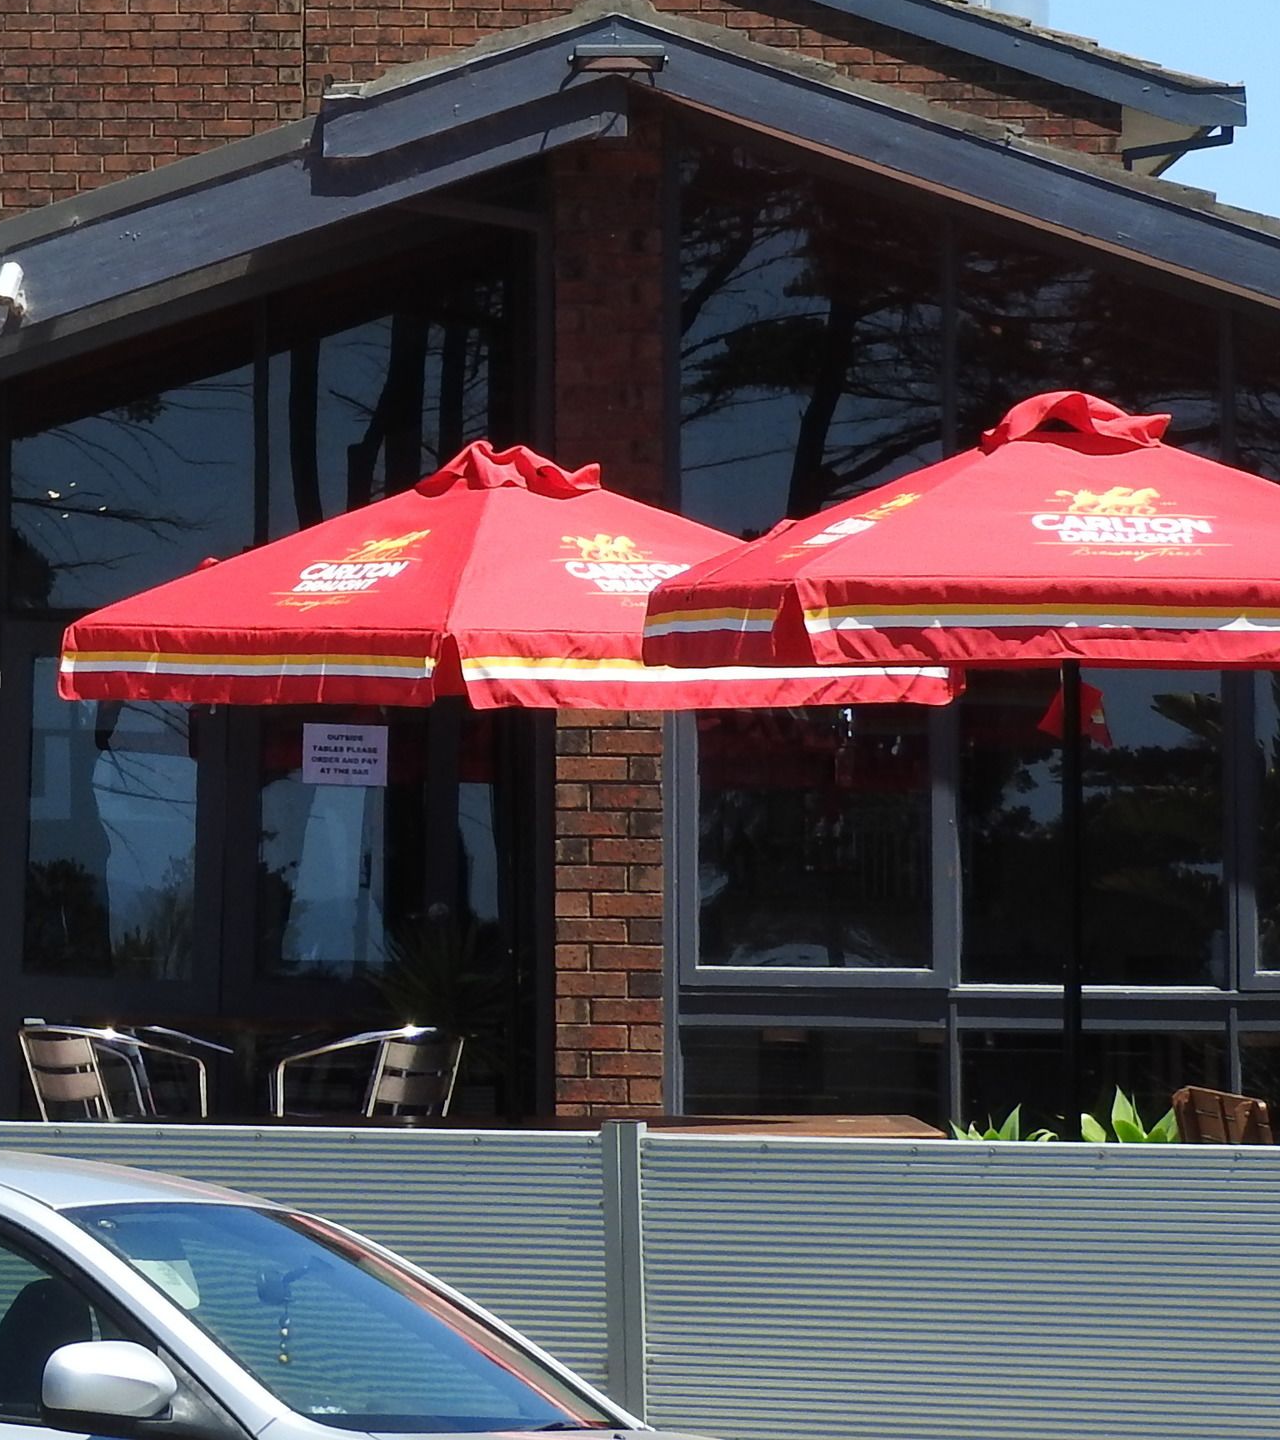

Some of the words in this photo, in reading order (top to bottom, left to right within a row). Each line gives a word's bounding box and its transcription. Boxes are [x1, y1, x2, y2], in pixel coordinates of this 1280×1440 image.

[1031, 513, 1213, 534] CARLTON
[299, 561, 410, 580] CARLTON
[327, 734, 364, 742] OUTSIDE
[312, 744, 344, 753] TABLES
[346, 746, 378, 754] PLEASE
[311, 756, 340, 764] ORDER
